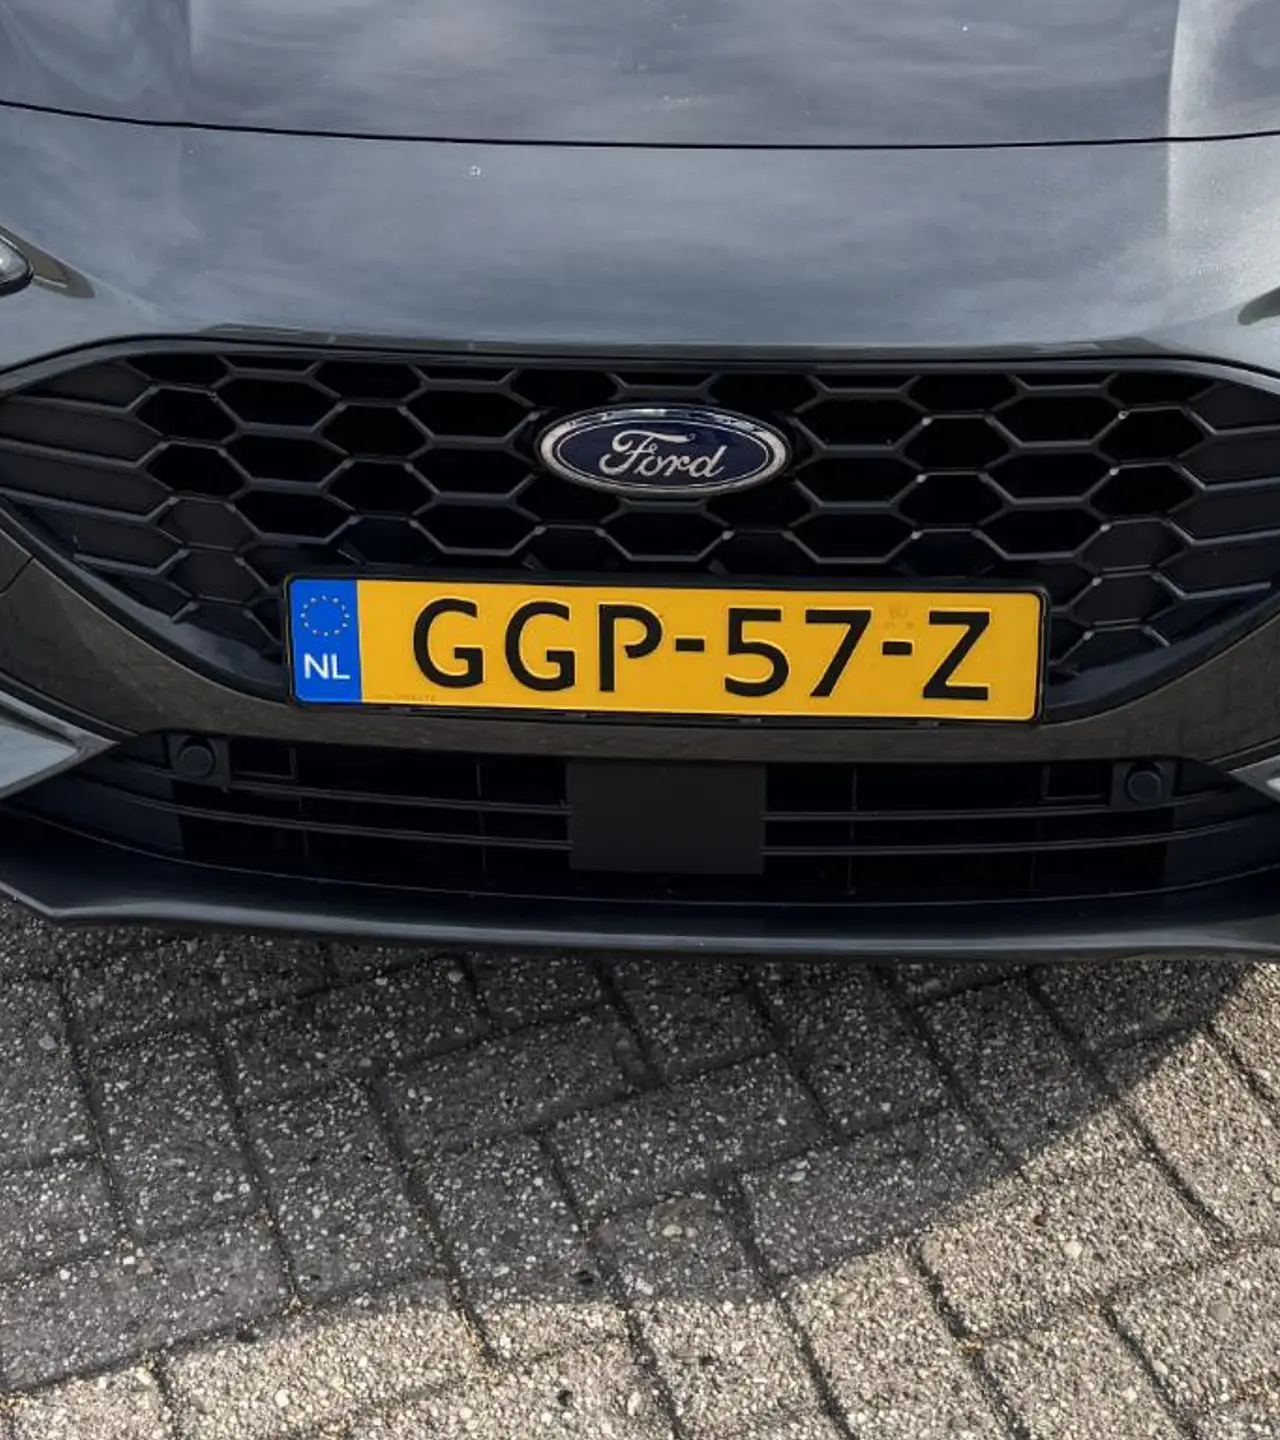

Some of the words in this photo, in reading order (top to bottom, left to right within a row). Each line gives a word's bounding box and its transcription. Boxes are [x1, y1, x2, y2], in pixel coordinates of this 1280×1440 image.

[599, 429, 728, 478] Ford
[304, 653, 350, 679] NL
[412, 597, 991, 701] GGP-57-Z
